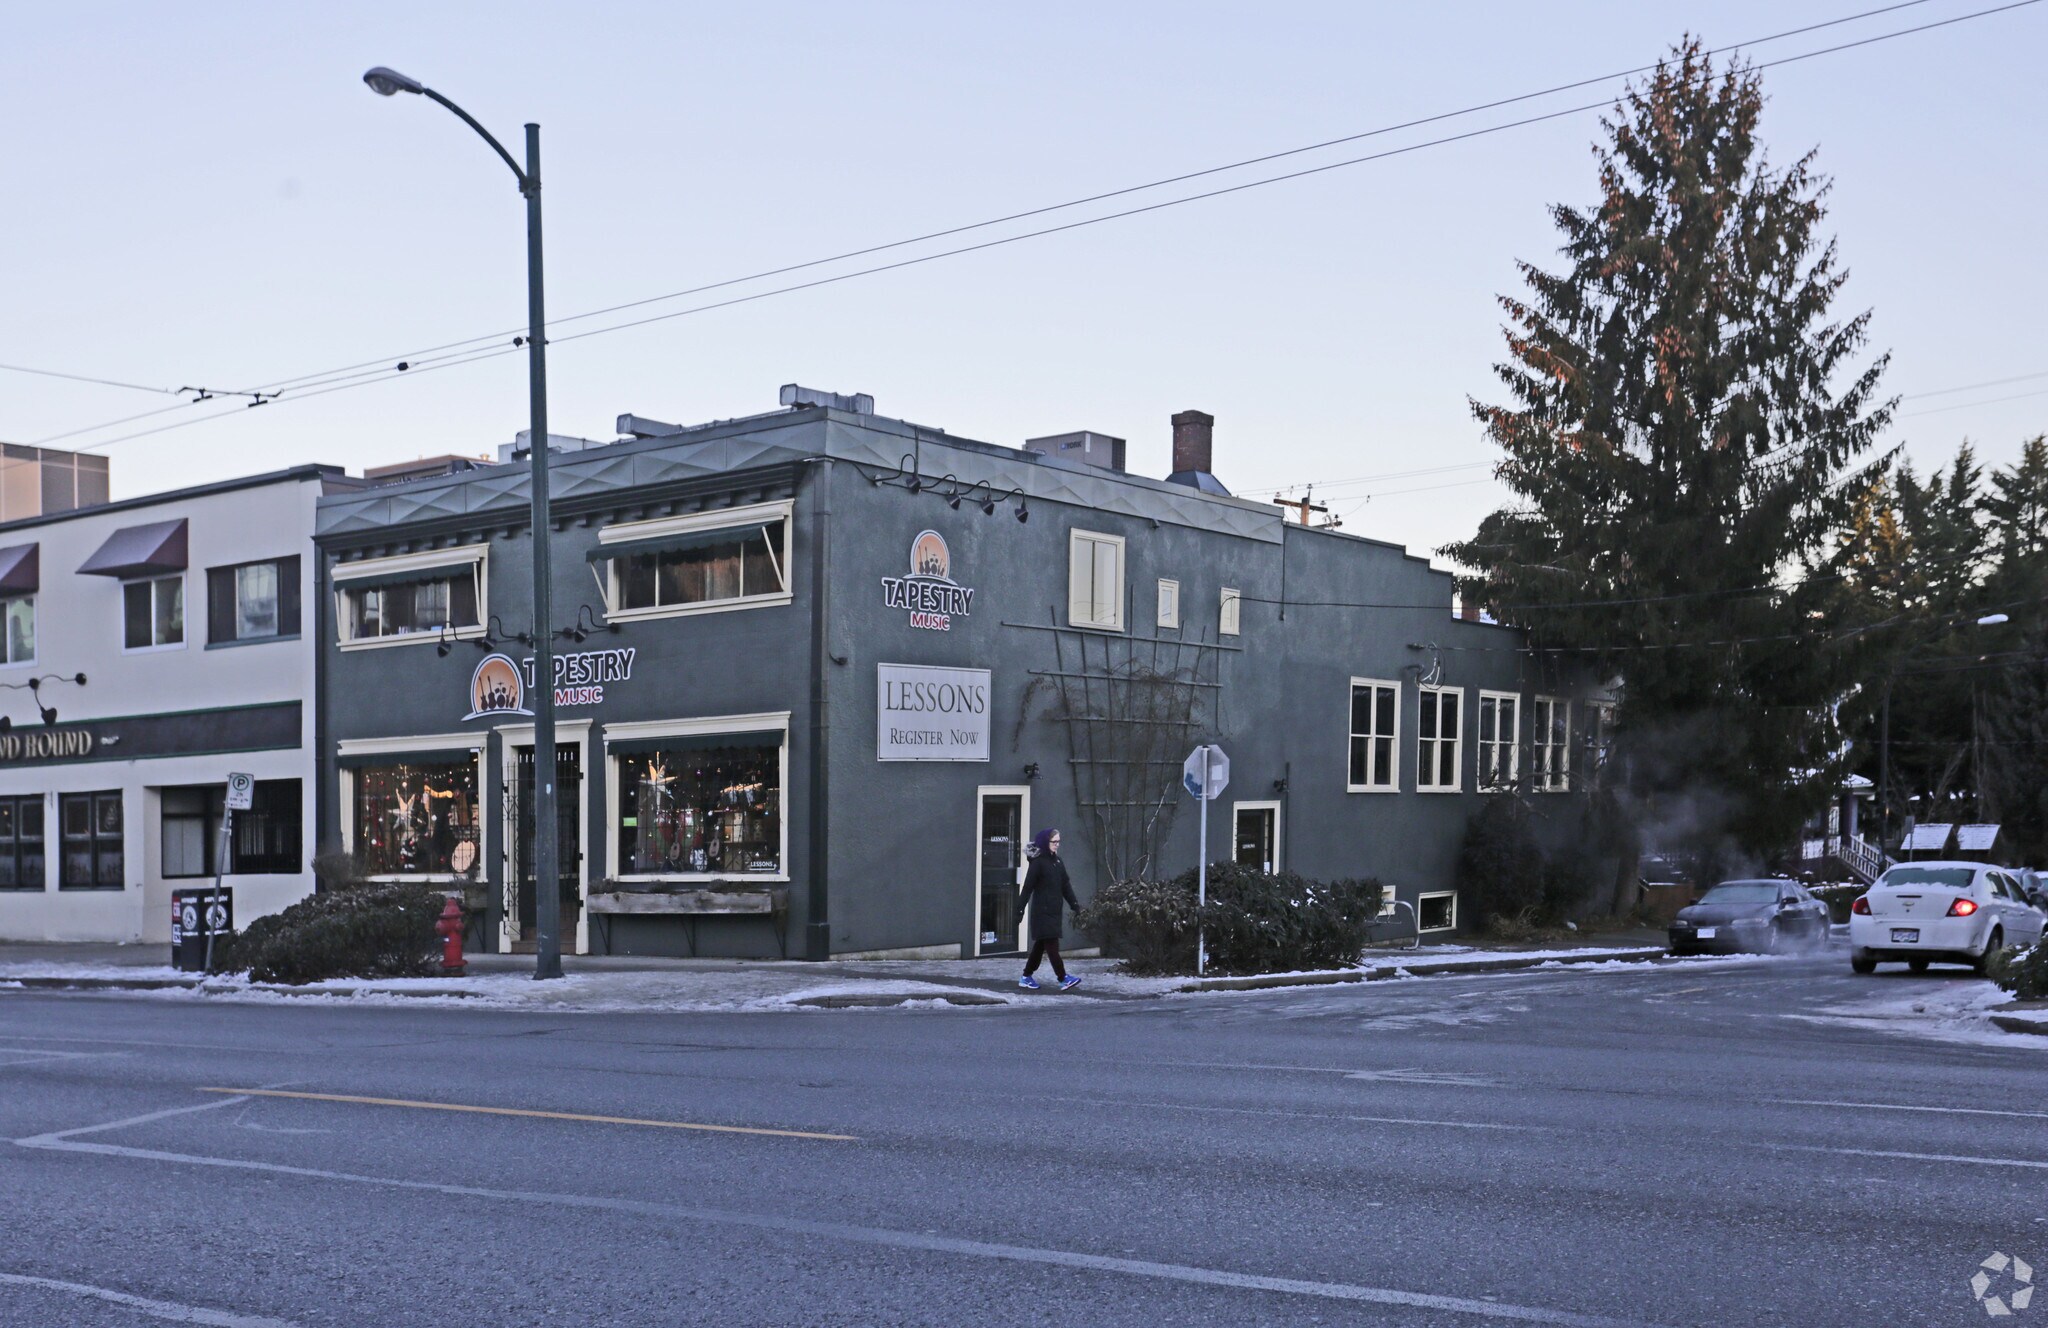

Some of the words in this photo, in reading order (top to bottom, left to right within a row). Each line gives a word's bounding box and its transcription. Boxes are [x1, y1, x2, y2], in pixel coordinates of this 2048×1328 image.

[882, 577, 974, 616] TAPESTRY
[911, 611, 950, 630] MUSIC
[523, 648, 635, 688] TPESTRY
[554, 686, 603, 706] MUSIC
[885, 681, 985, 714] LESSONS
[25, 730, 92, 758] HOUND
